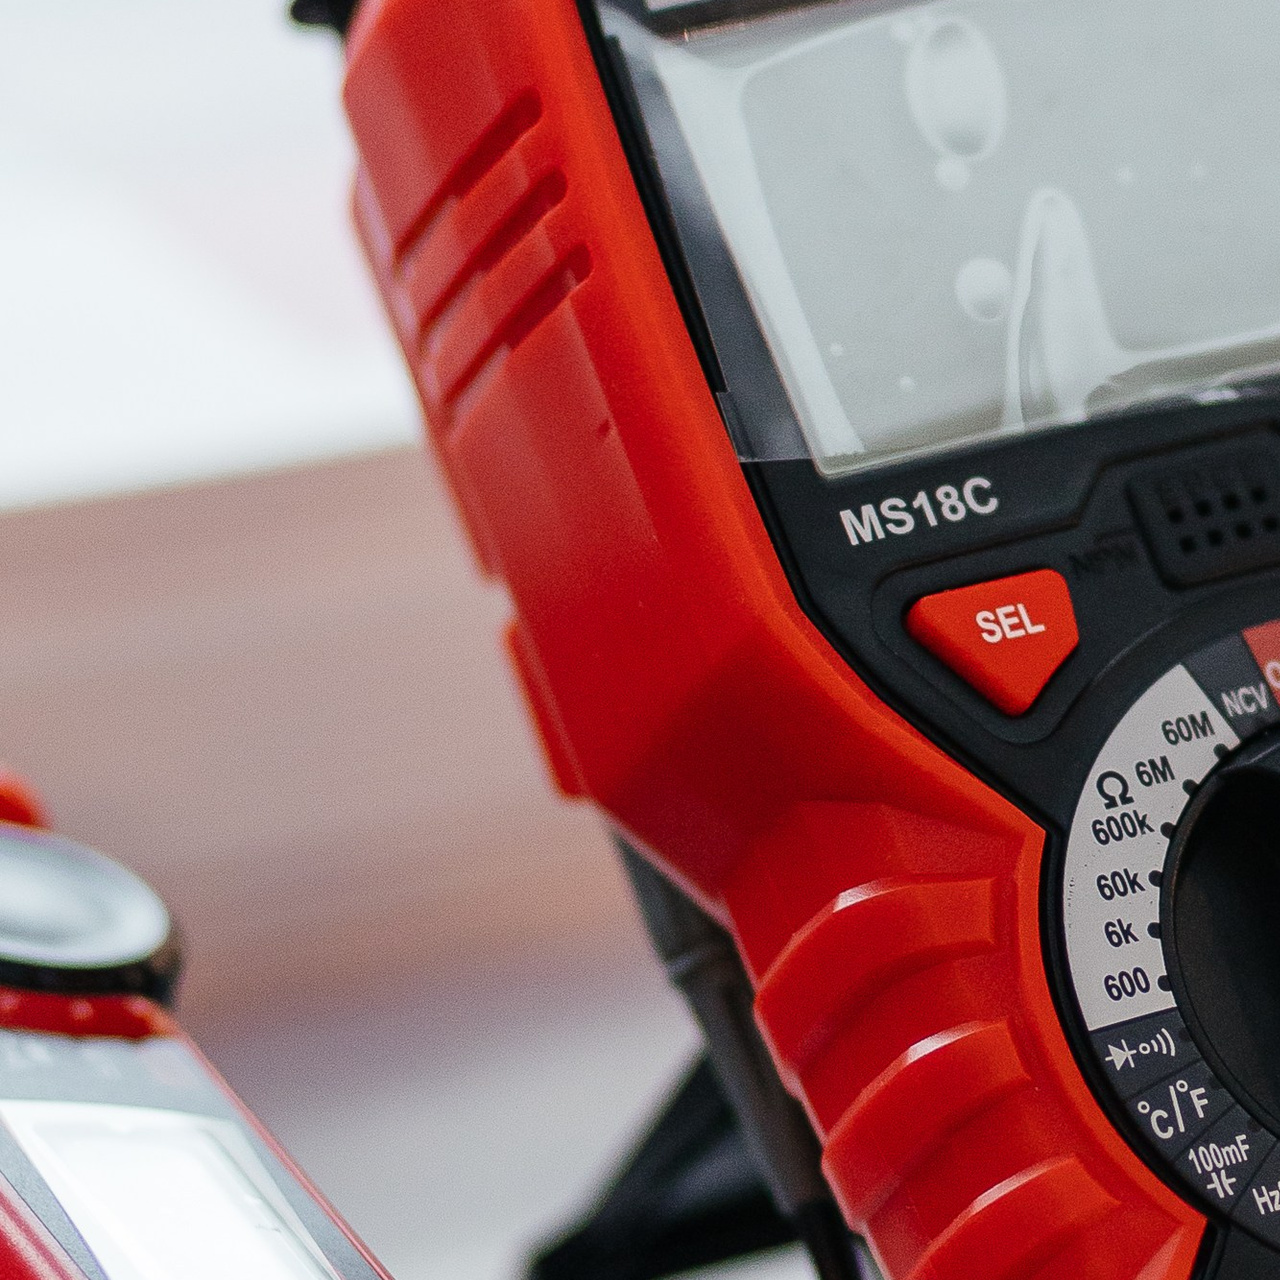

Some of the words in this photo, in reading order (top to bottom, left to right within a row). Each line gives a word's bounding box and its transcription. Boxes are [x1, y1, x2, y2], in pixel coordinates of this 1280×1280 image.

[840, 477, 998, 546] MS18C
[976, 603, 1045, 644] SEL
[1221, 683, 1269, 717] NCV
[1162, 711, 1215, 745] 60M
[1135, 756, 1175, 787] 6M
[1096, 771, 1134, 809] Ω
[1091, 810, 1155, 845] 600k
[1096, 868, 1146, 901] 60k
[1104, 918, 1139, 947] 6k
[1104, 967, 1150, 1001] 600
[1188, 1134, 1250, 1174] 100mF
